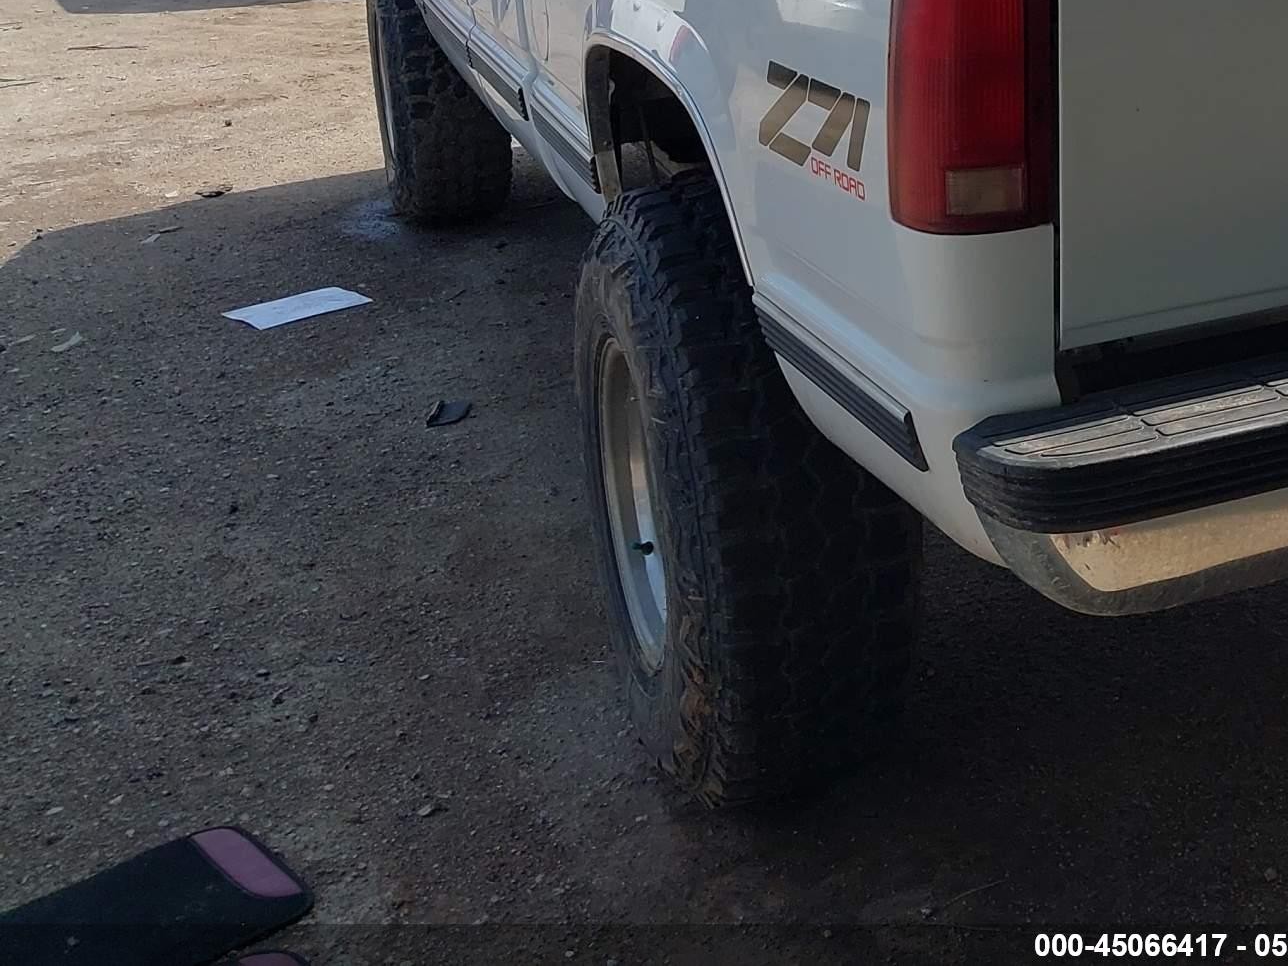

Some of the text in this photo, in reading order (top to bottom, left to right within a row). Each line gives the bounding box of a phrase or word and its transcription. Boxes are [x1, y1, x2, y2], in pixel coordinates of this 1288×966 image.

[759, 60, 871, 172] Z71
[810, 156, 866, 201] OFF ROAD
